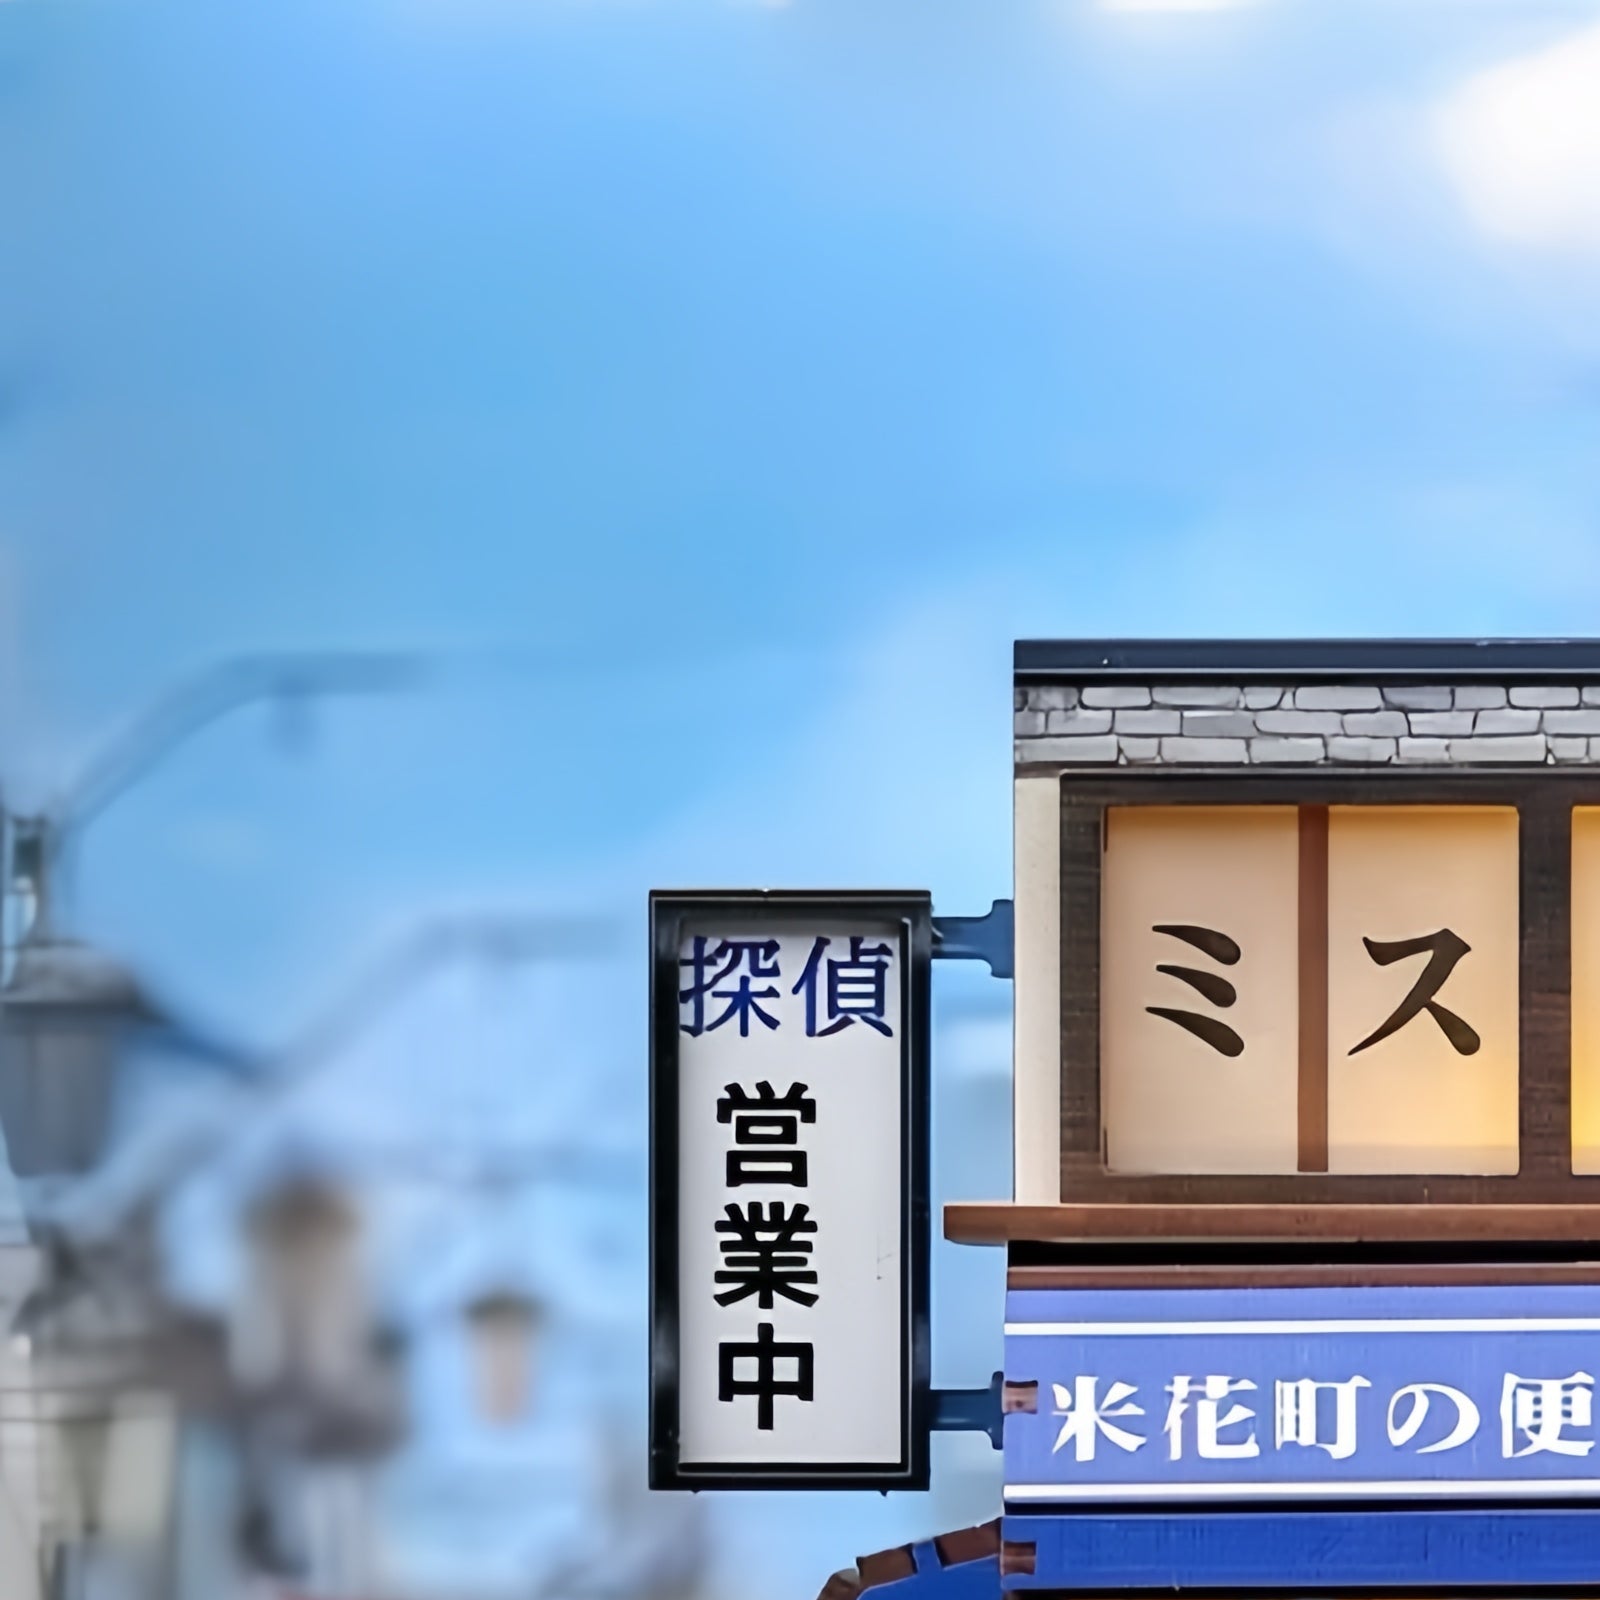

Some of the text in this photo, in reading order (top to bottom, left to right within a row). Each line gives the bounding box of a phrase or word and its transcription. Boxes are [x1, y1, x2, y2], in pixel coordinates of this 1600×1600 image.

[678, 936, 895, 1038] 探偵
[714, 1080, 820, 1431] 営業中
